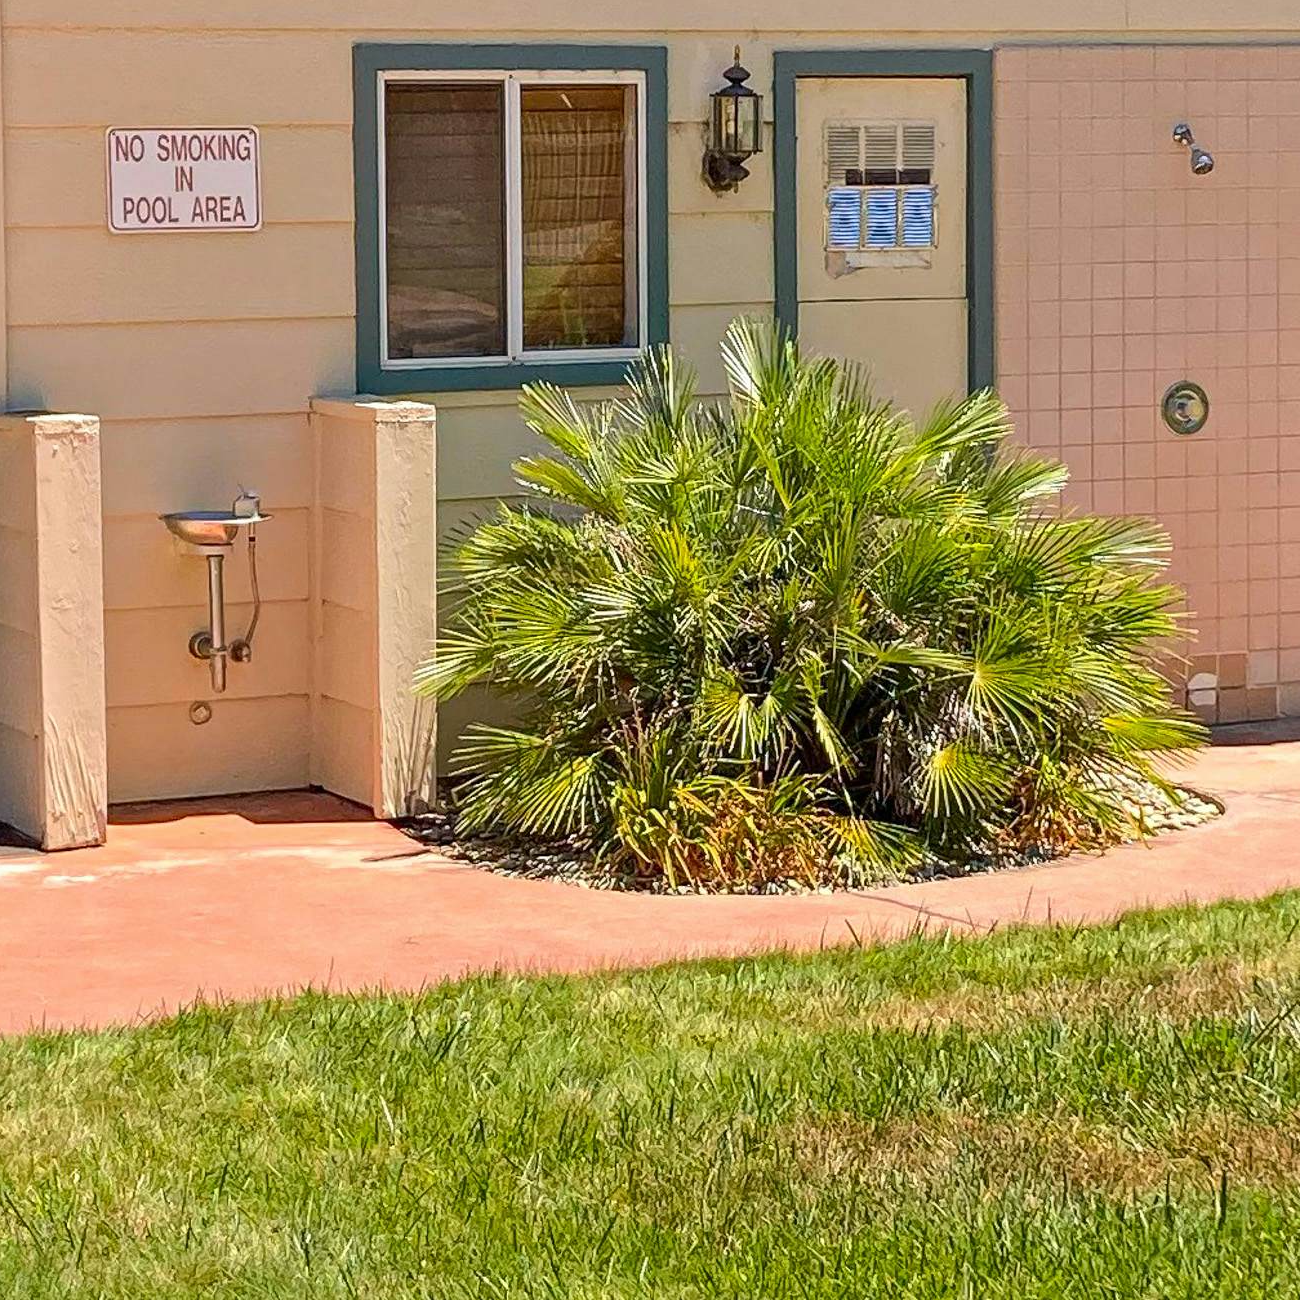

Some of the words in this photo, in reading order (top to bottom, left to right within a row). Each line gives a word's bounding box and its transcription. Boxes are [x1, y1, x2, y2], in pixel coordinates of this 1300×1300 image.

[115, 135, 144, 162] NO
[157, 134, 250, 162] SMOKING
[175, 166, 193, 192] IN
[123, 197, 179, 223] POOL
[191, 196, 246, 223] AREA
